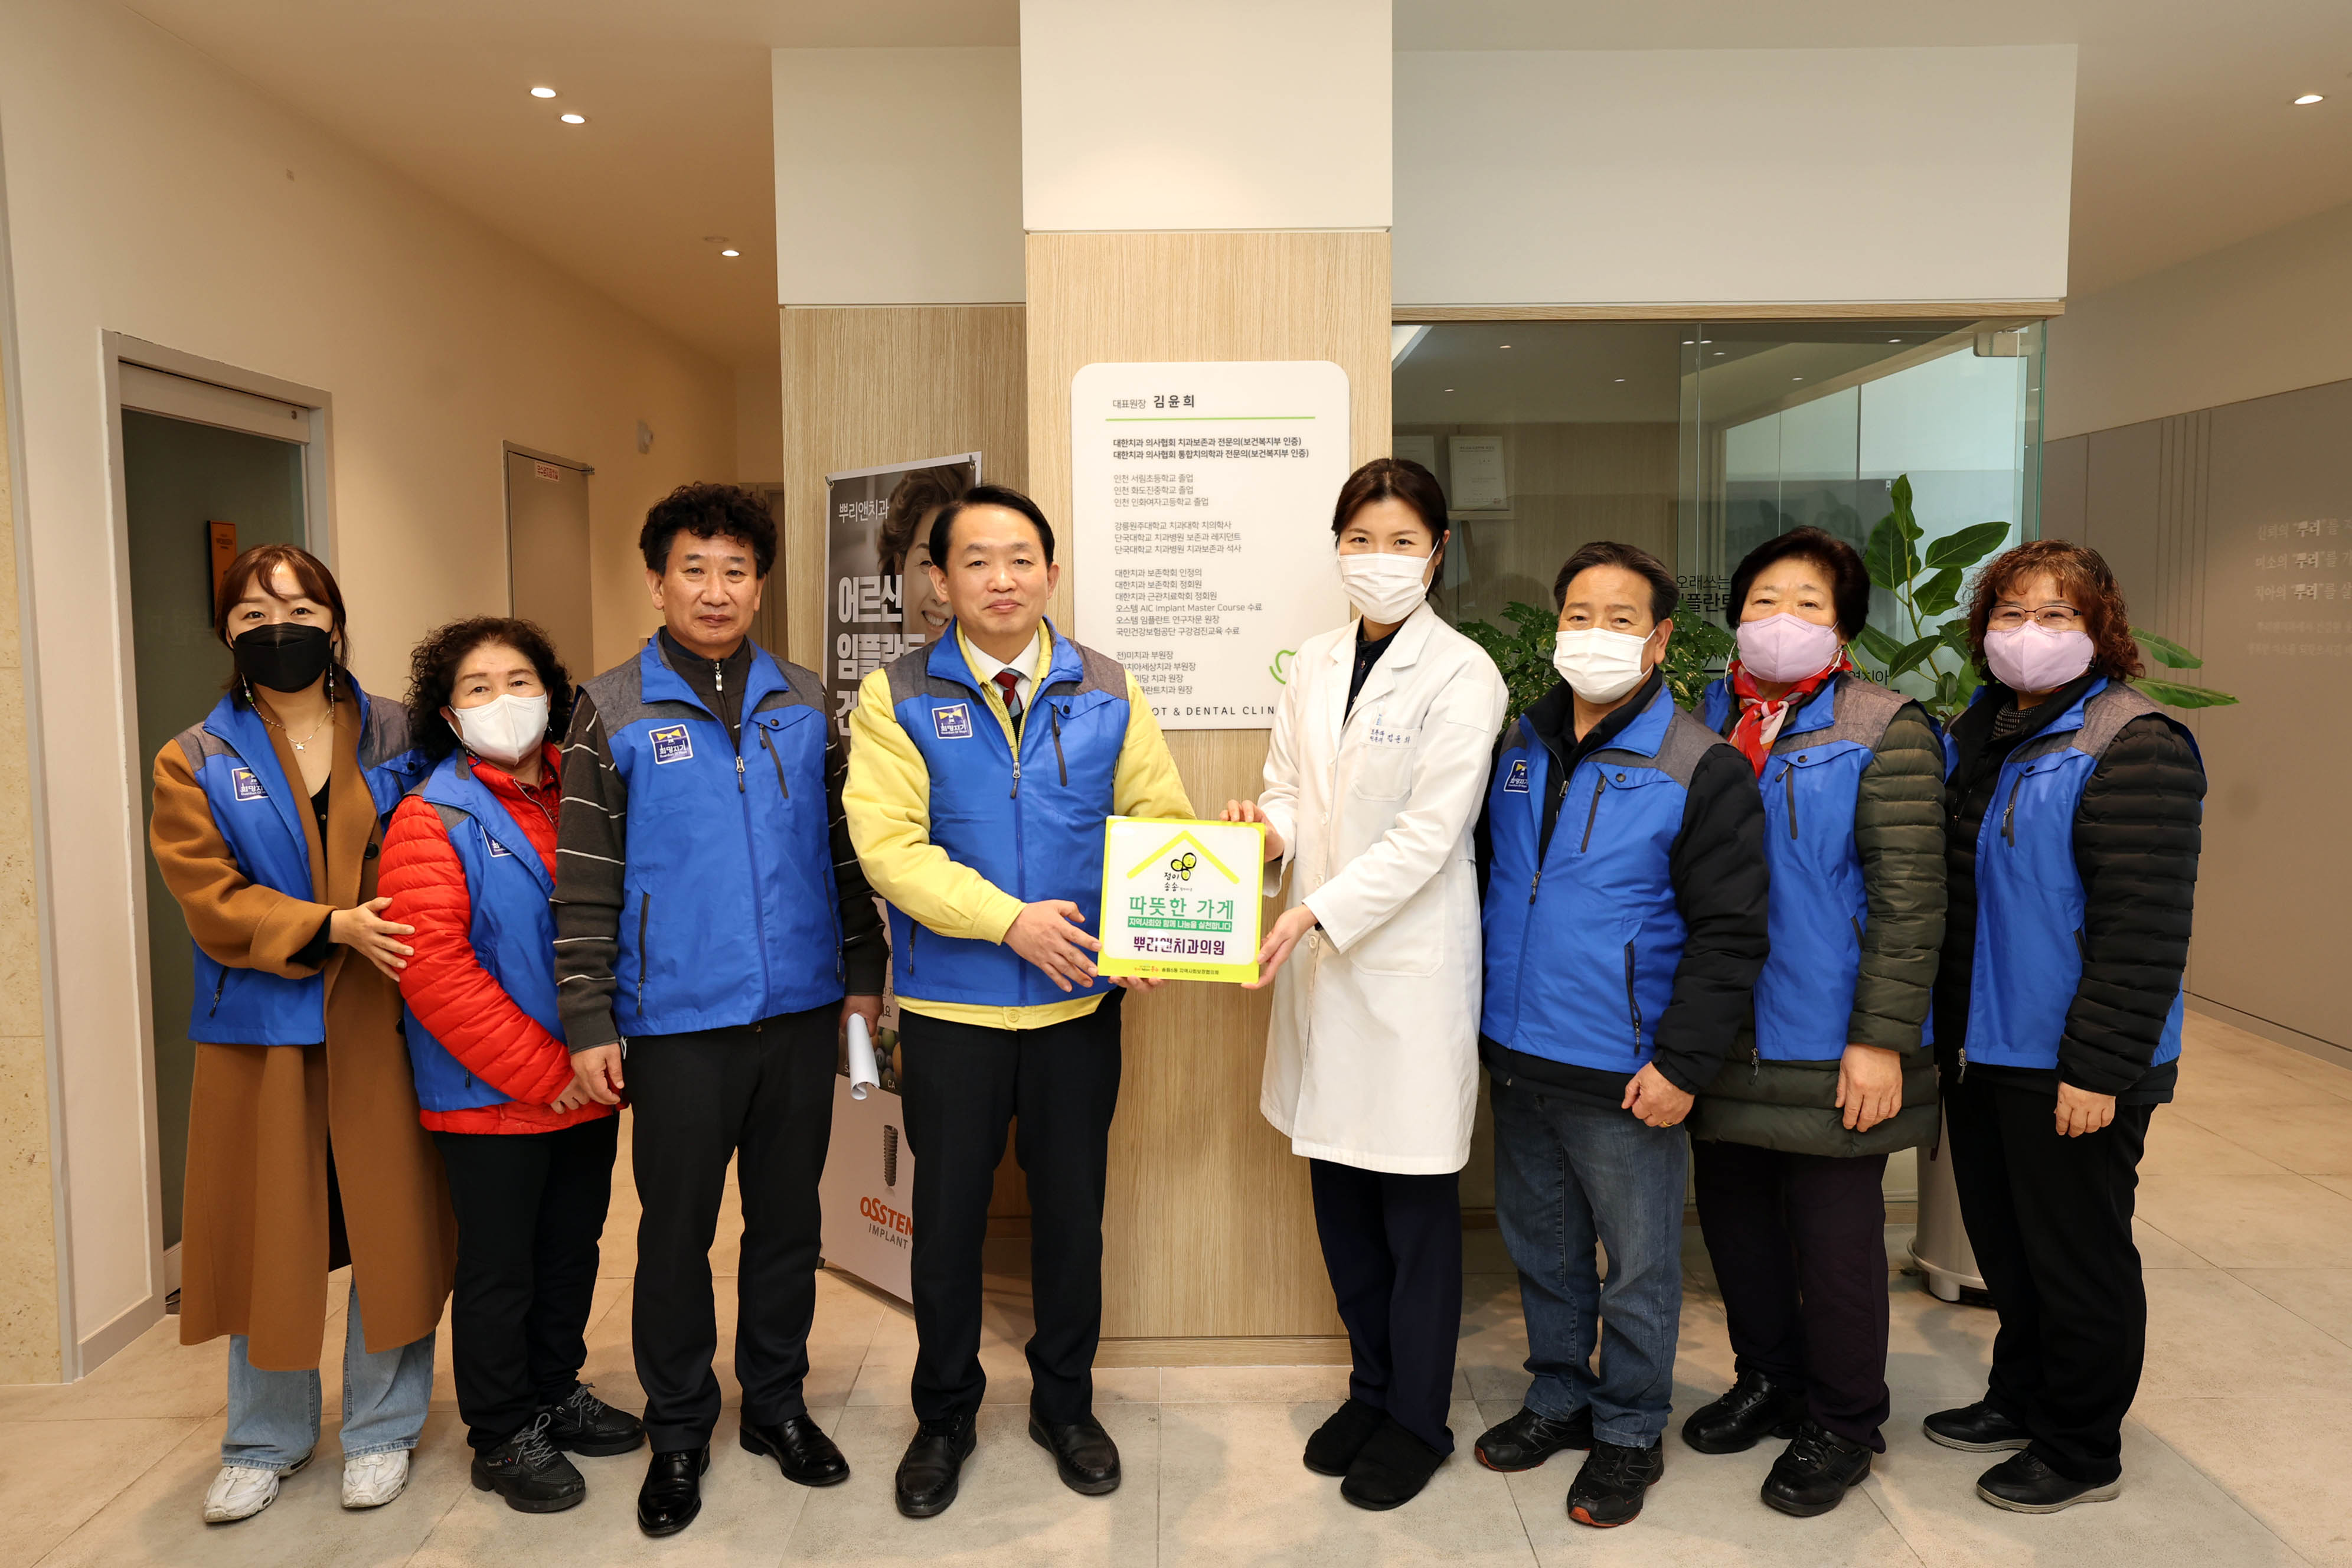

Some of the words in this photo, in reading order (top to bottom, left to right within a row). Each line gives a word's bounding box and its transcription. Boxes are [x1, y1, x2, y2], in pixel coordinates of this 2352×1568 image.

[1113, 399, 1146, 409] 대표원장
[1113, 438, 1144, 447] 대한치과
[1145, 438, 1175, 447] 의사협회
[1178, 437, 1216, 447] 치과보존과
[1218, 437, 1281, 447] 전문의(보건복지부
[1283, 436, 1301, 446] 인증)
[1113, 450, 1144, 459] 대한치과
[1145, 450, 1176, 459] 의사협회
[1178, 449, 1223, 459] 통합치의학과
[1226, 449, 1289, 458] 전문의(보건복지부
[1291, 449, 1309, 458] 인증)
[1113, 474, 1129, 484] 인천
[1131, 474, 1176, 484] 서림초등학교
[1178, 473, 1193, 483] 졸업
[1114, 486, 1129, 495] 인천
[1131, 486, 1176, 495] 화도진중학교
[1178, 485, 1193, 495] 졸업
[1114, 498, 1129, 507] 인천
[1131, 498, 1191, 507] 인화여자고등학교
[1194, 497, 1208, 507] 졸업
[838, 498, 889, 524] 뿌리앤치과
[1115, 522, 1167, 531] 강릉원주대학교
[1169, 521, 1199, 530] 치과대학
[1201, 521, 1231, 530] 치의학사
[1115, 534, 1152, 543] 단국대학교
[1154, 533, 1184, 542] 치과병원
[1186, 533, 1209, 542] 보존과
[1211, 533, 1242, 541] 레지던트
[1115, 545, 1152, 554] 단국대학교
[1154, 545, 1184, 554] 치과병원
[1186, 544, 1224, 554] 치과보존과
[1226, 544, 1242, 553] 석사
[1115, 569, 1145, 578] 대한치과
[1148, 569, 1177, 577] 보존학회
[1180, 568, 1202, 577] 인정의
[1115, 581, 1145, 590] 대한치과
[1148, 580, 1177, 589] 보존학회
[1180, 580, 1202, 589] 정회원
[1677, 575, 1731, 590] 오래쓰는
[838, 574, 903, 623] 어르신
[1115, 593, 1145, 602] 대한치과
[1148, 592, 1193, 601] 근관치료학회
[1195, 591, 1217, 600] 정회원
[1115, 605, 1138, 613] 오스템
[1156, 605, 1185, 613] Implant
[1217, 603, 1245, 612] Course
[1115, 617, 1138, 625] 오스템
[1141, 616, 1171, 625] 임플란트
[1172, 616, 1202, 625] 연구자문
[1204, 615, 1220, 624] 원장
[1116, 628, 1175, 637] 국민건강보험공단
[1178, 627, 1223, 636] 구강검진교육
[1225, 627, 1240, 635] 수료
[1116, 651, 1149, 661] 전)미치과
[1151, 651, 1173, 660] 부원장
[1123, 663, 1171, 672] )치아세상치과
[1174, 662, 1195, 671] 부원장
[1152, 675, 1167, 683] 치과
[1168, 674, 1183, 683] 원장
[1178, 685, 1193, 695] 원장
[1152, 707, 1167, 716] OT
[1173, 707, 1180, 716] &
[1186, 706, 1236, 716] DENTAL
[1243, 705, 1274, 715] CLIN
[940, 720, 966, 731] 희망지기
[659, 740, 687, 754] 희망지기
[240, 782, 263, 792] 희망지
[1129, 896, 1187, 917] 따뜻한
[1197, 899, 1234, 920] 가게
[1129, 917, 1161, 927] 지역사회와
[1162, 919, 1177, 927] 함께
[1198, 920, 1231, 930] 실천합니다
[1133, 936, 1225, 955] 뿌리앤치과의원
[868, 1223, 908, 1250] IMPLANT
